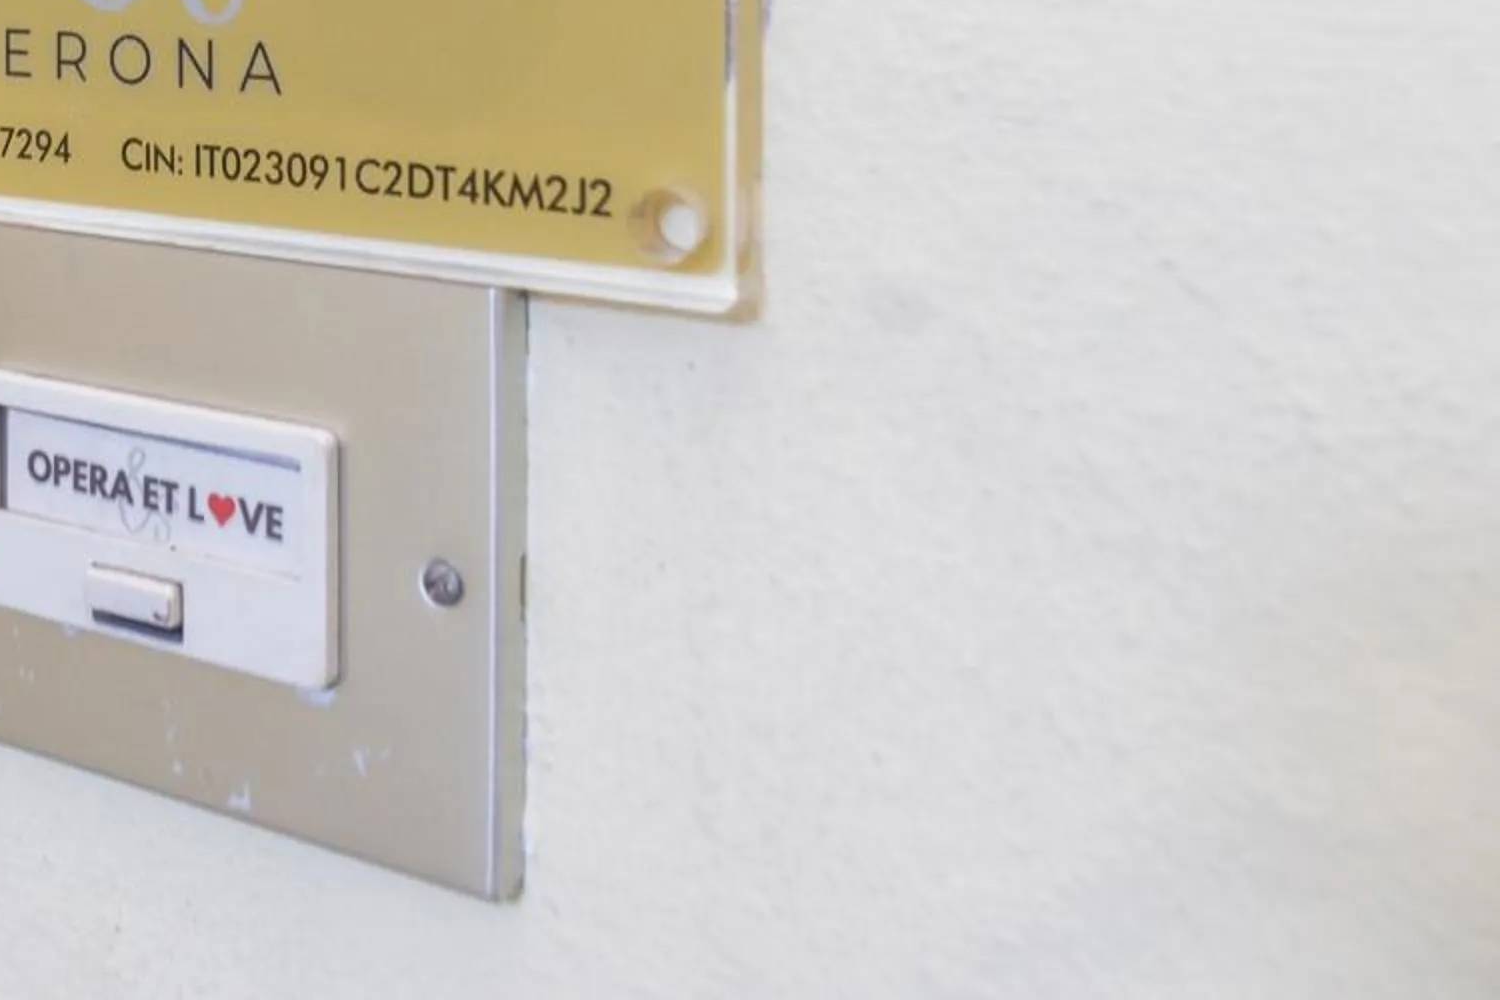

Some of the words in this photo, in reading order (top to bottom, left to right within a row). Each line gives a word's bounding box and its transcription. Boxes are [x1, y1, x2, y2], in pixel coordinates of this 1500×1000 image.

[120, 136, 184, 180] CIN:
[194, 143, 615, 217] IT023091C2DT4KM2J2
[27, 449, 134, 504] OPERA
[142, 476, 179, 516] ET
